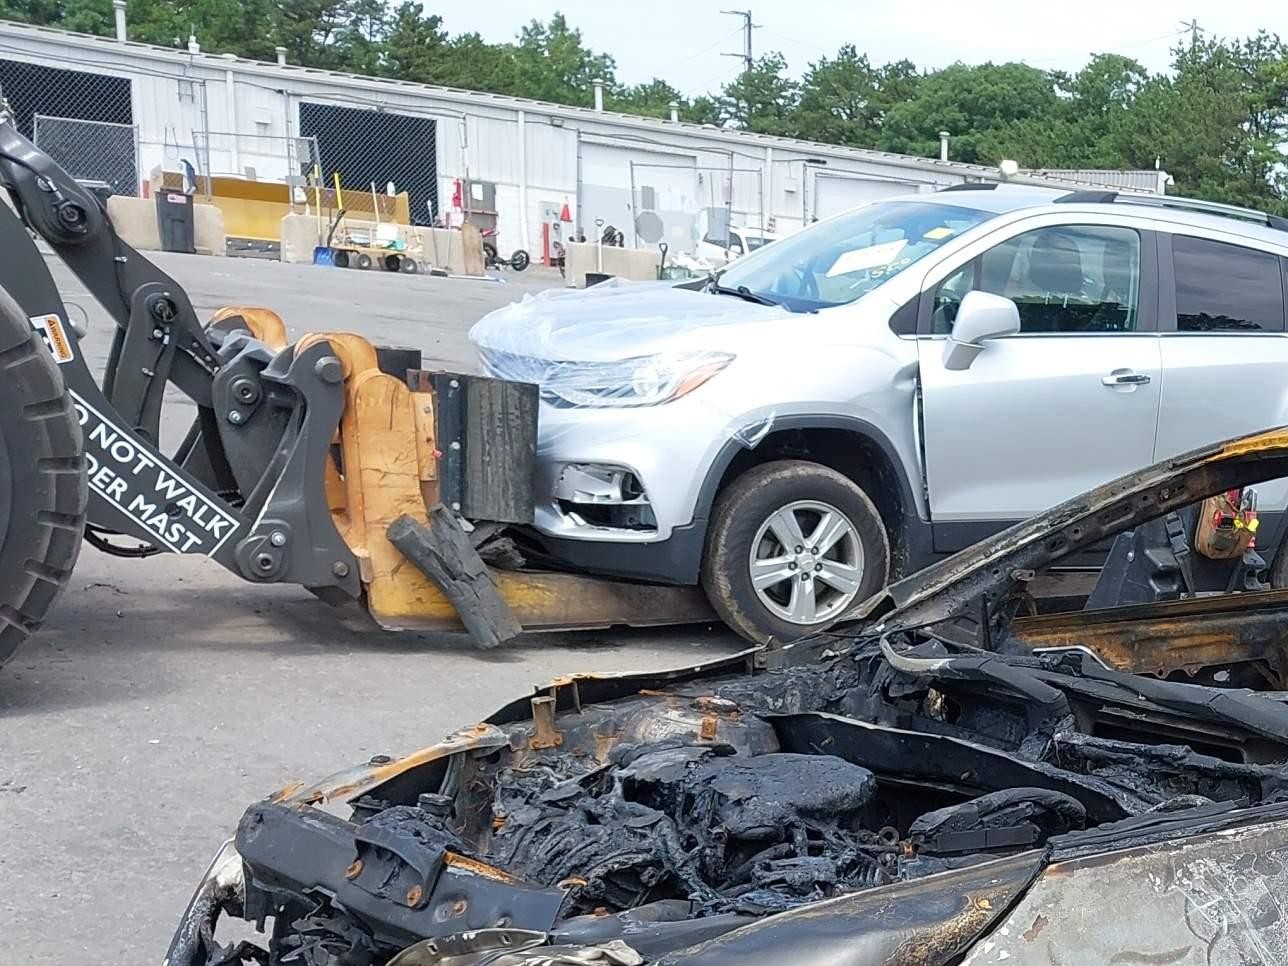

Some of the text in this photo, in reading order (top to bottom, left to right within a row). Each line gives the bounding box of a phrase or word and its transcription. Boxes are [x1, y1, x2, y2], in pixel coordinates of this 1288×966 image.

[85, 451, 203, 552] DER MAST
[88, 422, 154, 475] NOT
[154, 470, 230, 539] WALK
